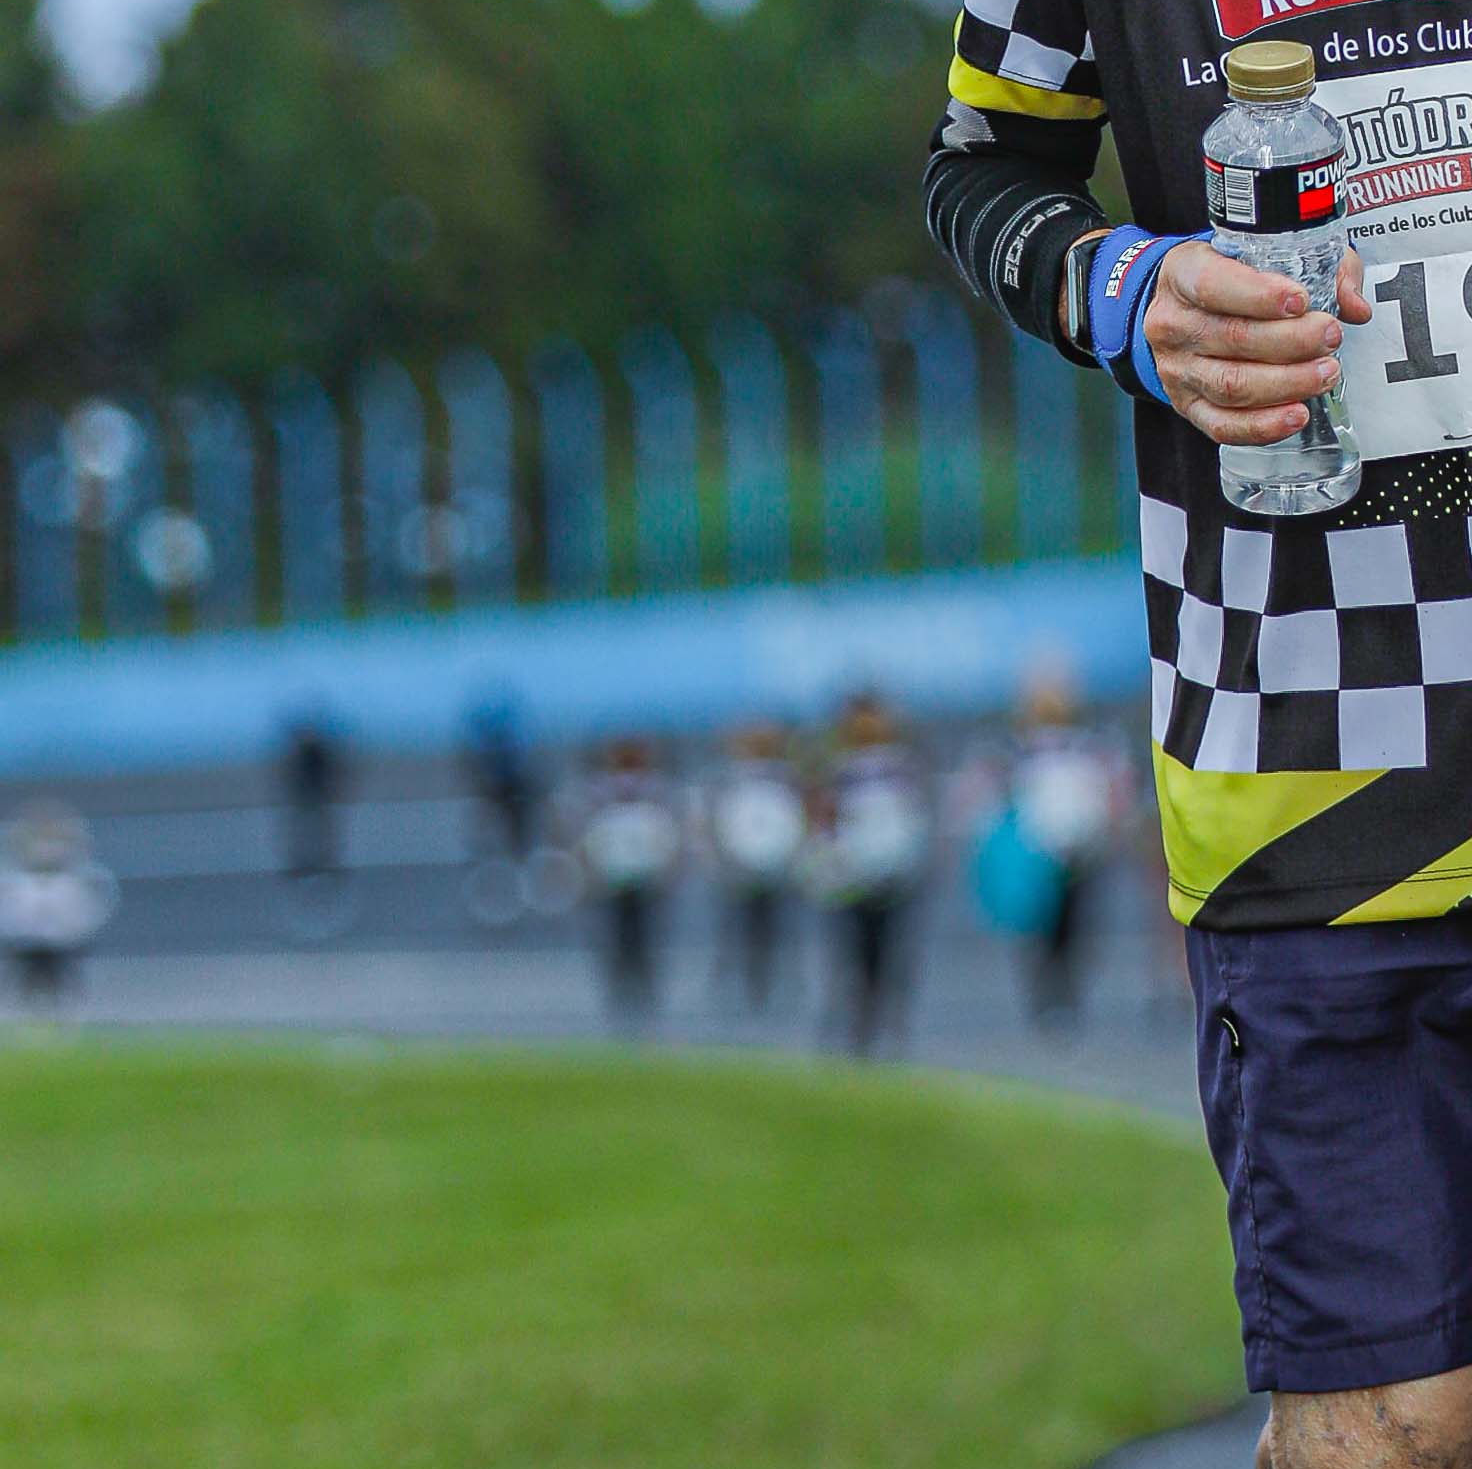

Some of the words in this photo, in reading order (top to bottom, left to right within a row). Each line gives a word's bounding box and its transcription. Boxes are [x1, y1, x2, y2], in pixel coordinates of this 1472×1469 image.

[1181, 57, 1218, 87] La
[1323, 32, 1360, 63] de
[1367, 27, 1409, 59] los
[1348, 160, 1463, 211] RUNNING
[1347, 223, 1386, 239] rrera
[1389, 216, 1410, 233] de
[1412, 213, 1436, 229] los
